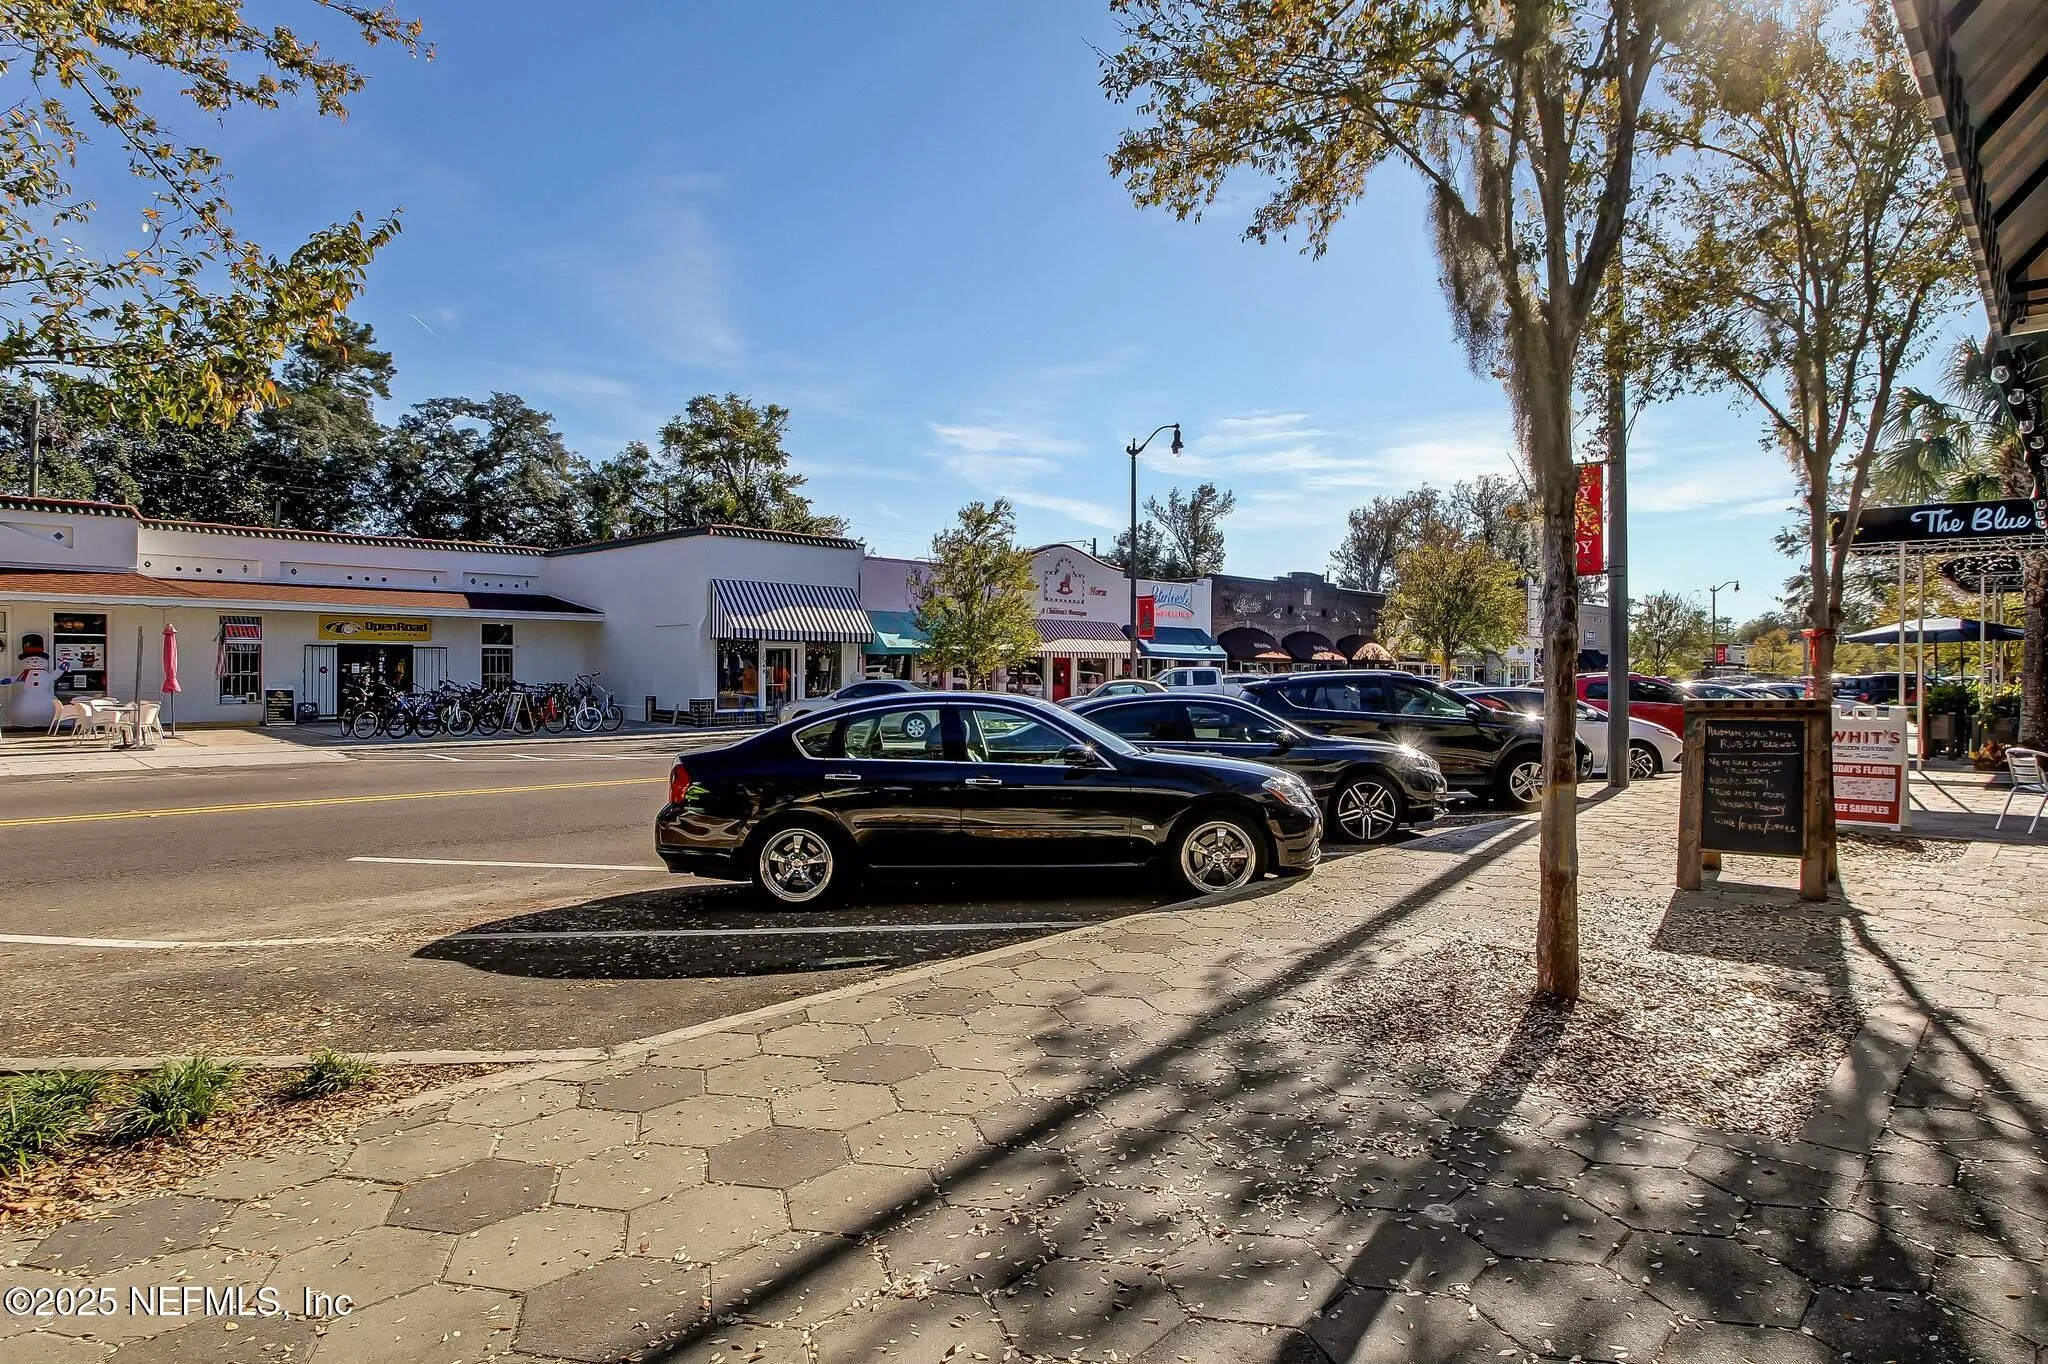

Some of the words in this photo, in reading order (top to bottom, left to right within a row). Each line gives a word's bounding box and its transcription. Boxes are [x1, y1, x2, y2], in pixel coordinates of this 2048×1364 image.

[1910, 509, 1965, 533] The
[1971, 505, 2032, 532] Blue
[1832, 730, 1900, 745] WHIT'S
[1832, 764, 1862, 774] ODAY'S
[1862, 766, 1896, 775] FLAVOR
[1834, 802, 1848, 813] REE
[1849, 803, 1890, 815] SAMPLES
